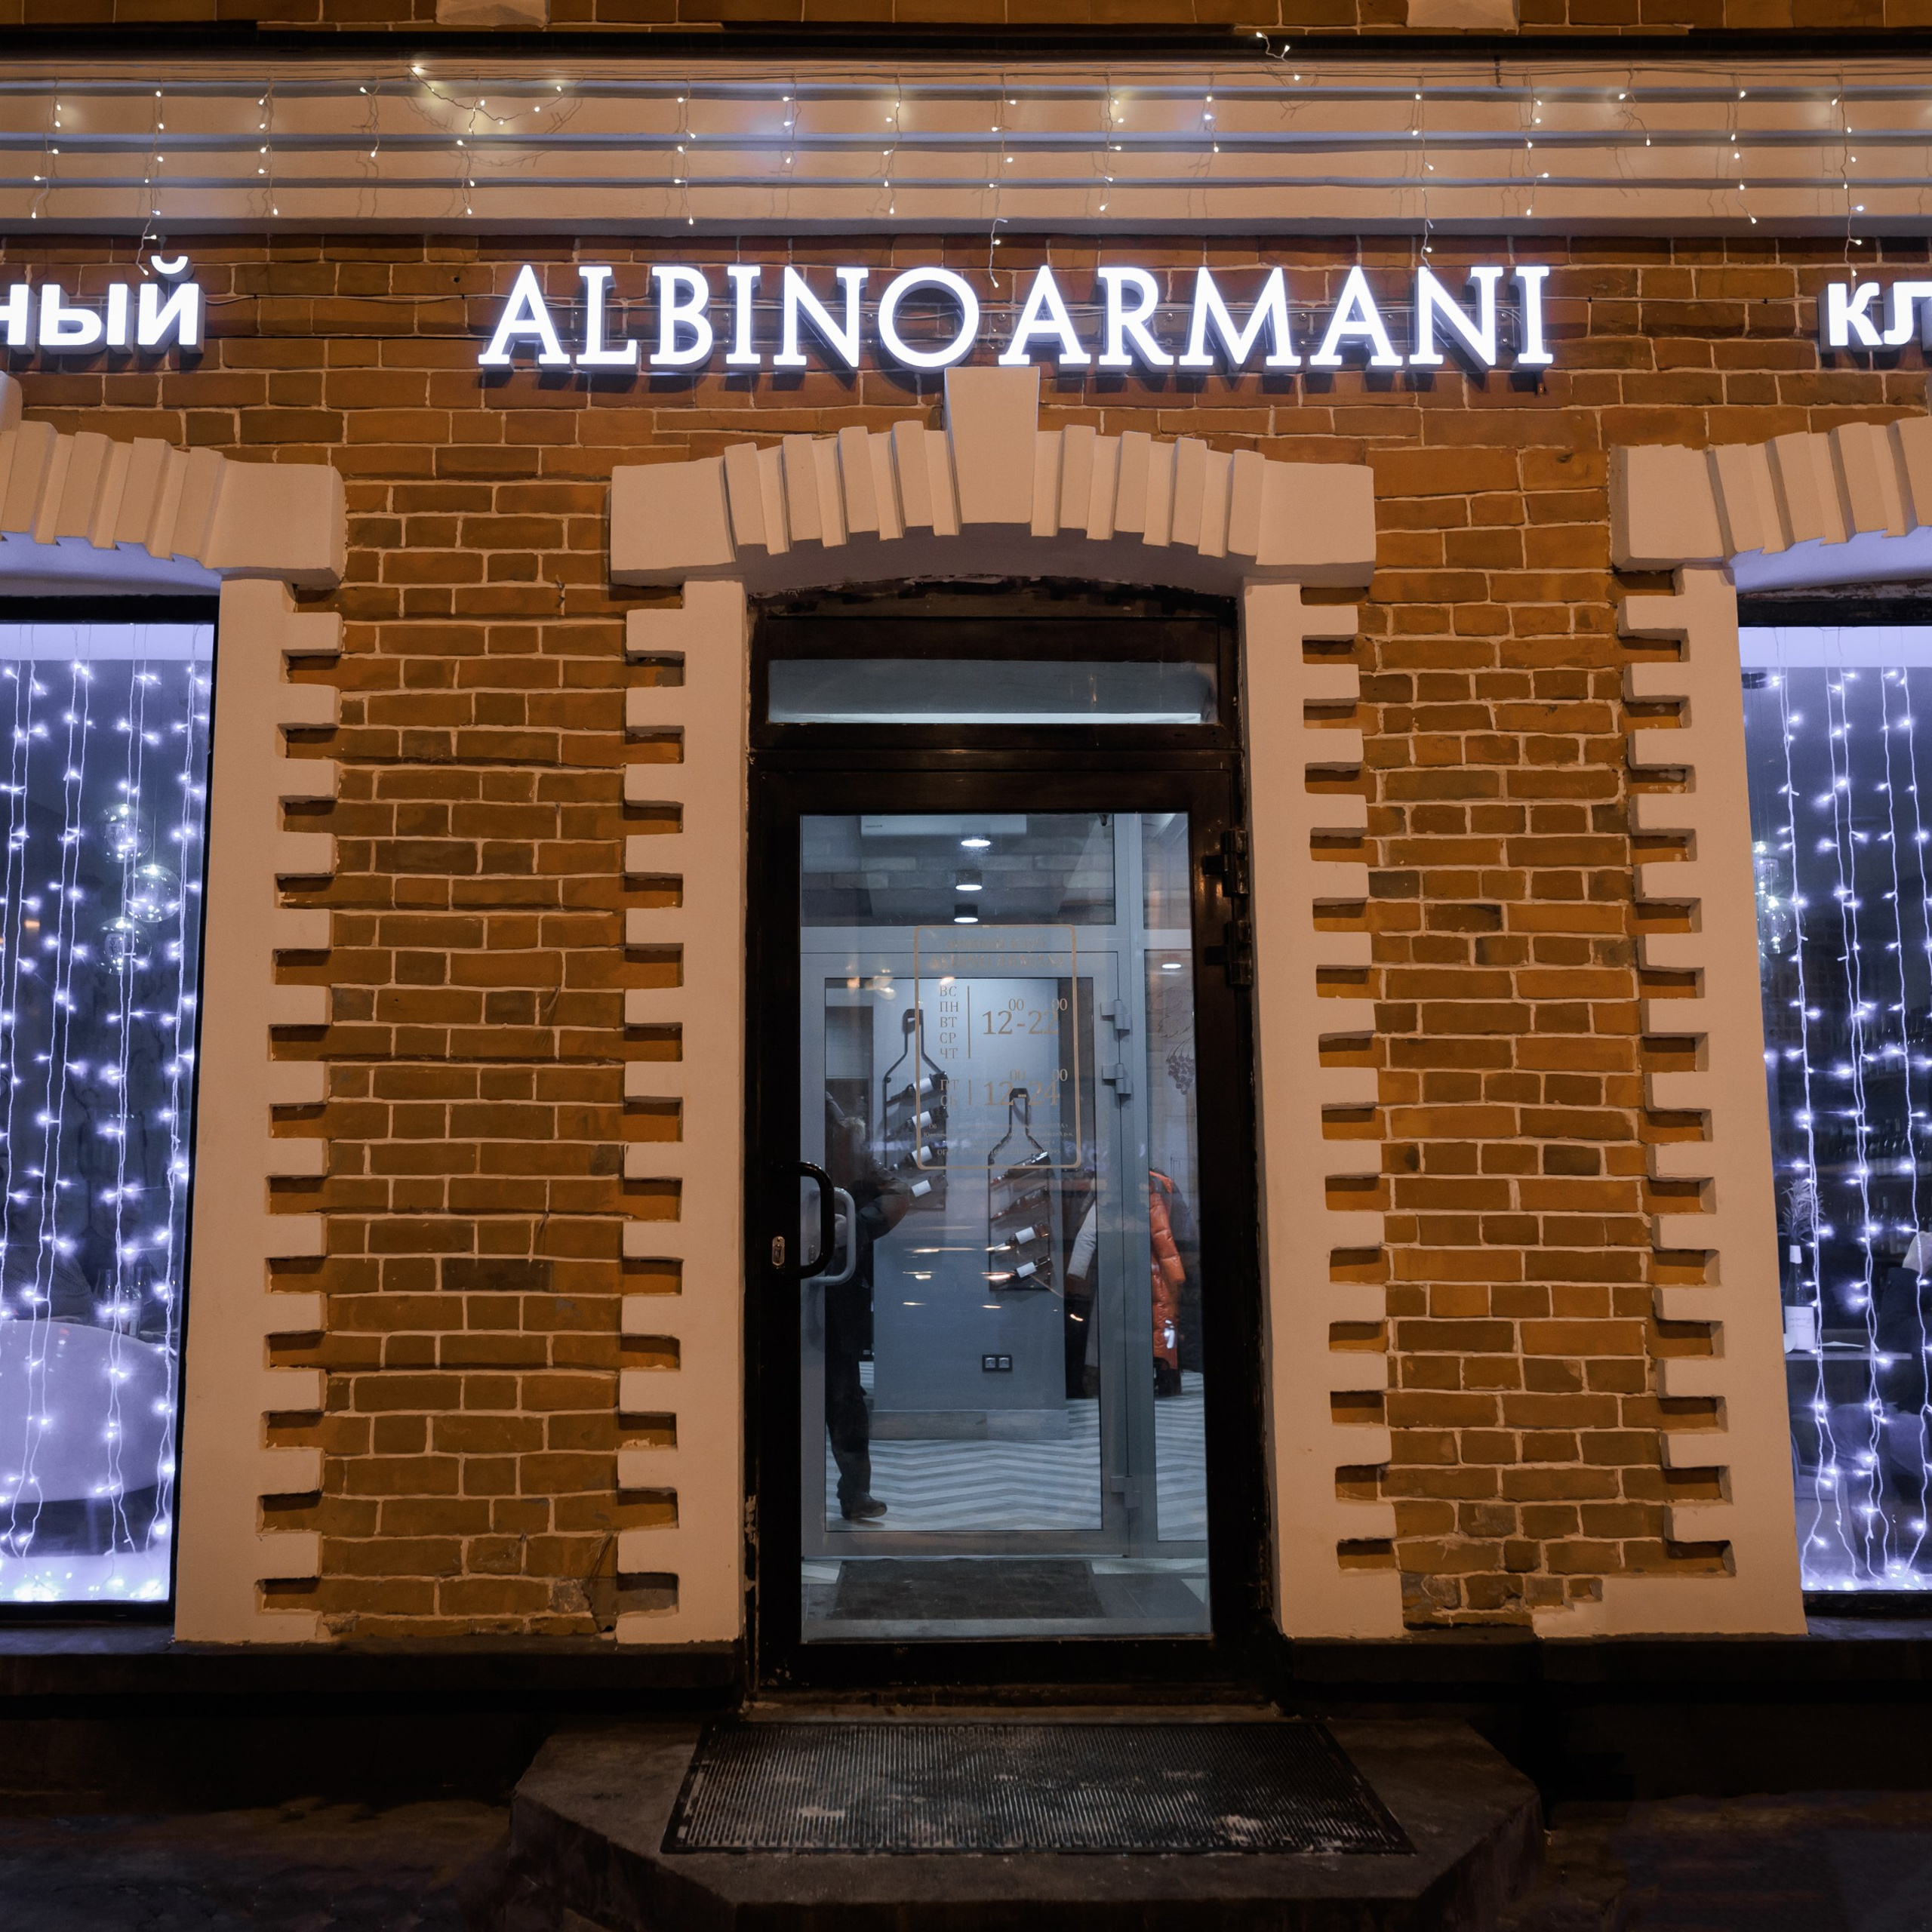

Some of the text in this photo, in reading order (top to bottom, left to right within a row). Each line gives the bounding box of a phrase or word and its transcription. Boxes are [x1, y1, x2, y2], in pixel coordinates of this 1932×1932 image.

[478, 264, 1554, 368] ALBINO ARMANI
[939, 986, 957, 997] ВС
[940, 1001, 959, 1012] ПН
[940, 1017, 958, 1028] ВТ
[940, 1032, 956, 1044] СР
[940, 1048, 958, 1059] ЧТ
[940, 1079, 959, 1091] ПТ
